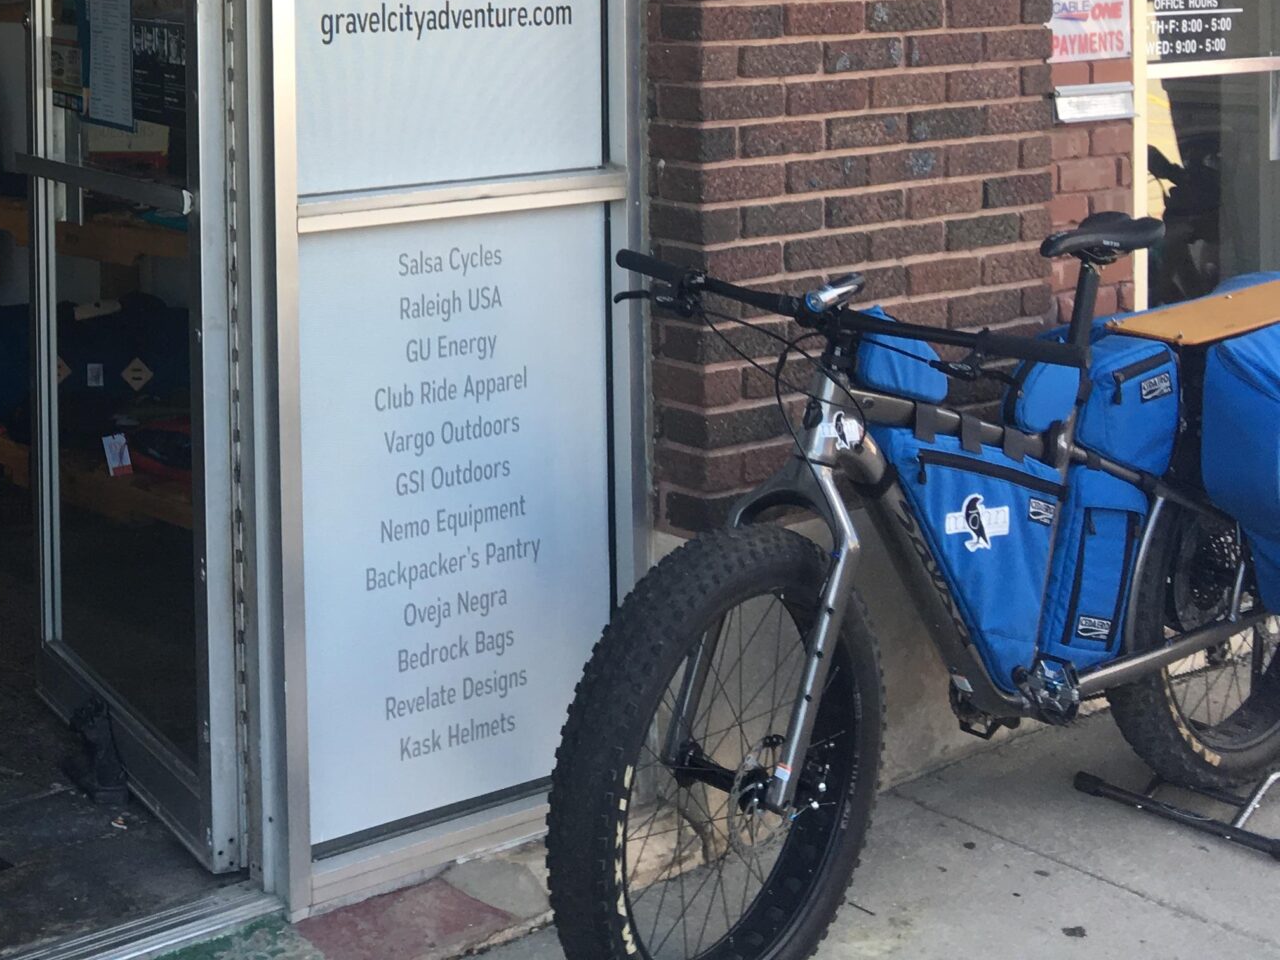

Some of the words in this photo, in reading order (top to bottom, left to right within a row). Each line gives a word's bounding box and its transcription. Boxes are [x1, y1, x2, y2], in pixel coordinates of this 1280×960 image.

[321, 0, 572, 45] gravelcityadventure.com
[1052, 0, 1090, 15] CABLE
[1090, 2, 1123, 21] ONE
[1181, 18, 1203, 33] 8:00
[1211, 17, 1232, 31] 5:00
[1052, 30, 1124, 56] PAYMENTS
[1176, 40, 1196, 54] 9:00
[1205, 38, 1226, 52] 5:00
[398, 250, 443, 277] Salsa
[449, 244, 502, 278] Cycles
[399, 290, 461, 323] Raleigh
[468, 285, 502, 312] USA
[406, 339, 431, 363] GU
[437, 333, 497, 362] Energy
[375, 384, 414, 413] Club
[420, 377, 457, 406] Ride
[463, 366, 528, 403] Apparel
[384, 428, 435, 458] Vargo
[441, 416, 520, 445] Outdoors
[395, 468, 425, 497] GSI
[431, 460, 510, 491] Outdoors
[380, 515, 430, 544] Nemo
[436, 495, 526, 536] Equipment
[366, 546, 480, 591] Backpacker's
[485, 536, 541, 566] Pantry
[403, 595, 451, 627] Oveja
[457, 588, 508, 617] Negra
[398, 634, 469, 673] Bedrock
[475, 627, 514, 658] Bags
[385, 686, 456, 721] Revelate
[462, 667, 528, 704] Designs
[399, 729, 442, 761] Kask
[448, 711, 516, 748] Helmets
